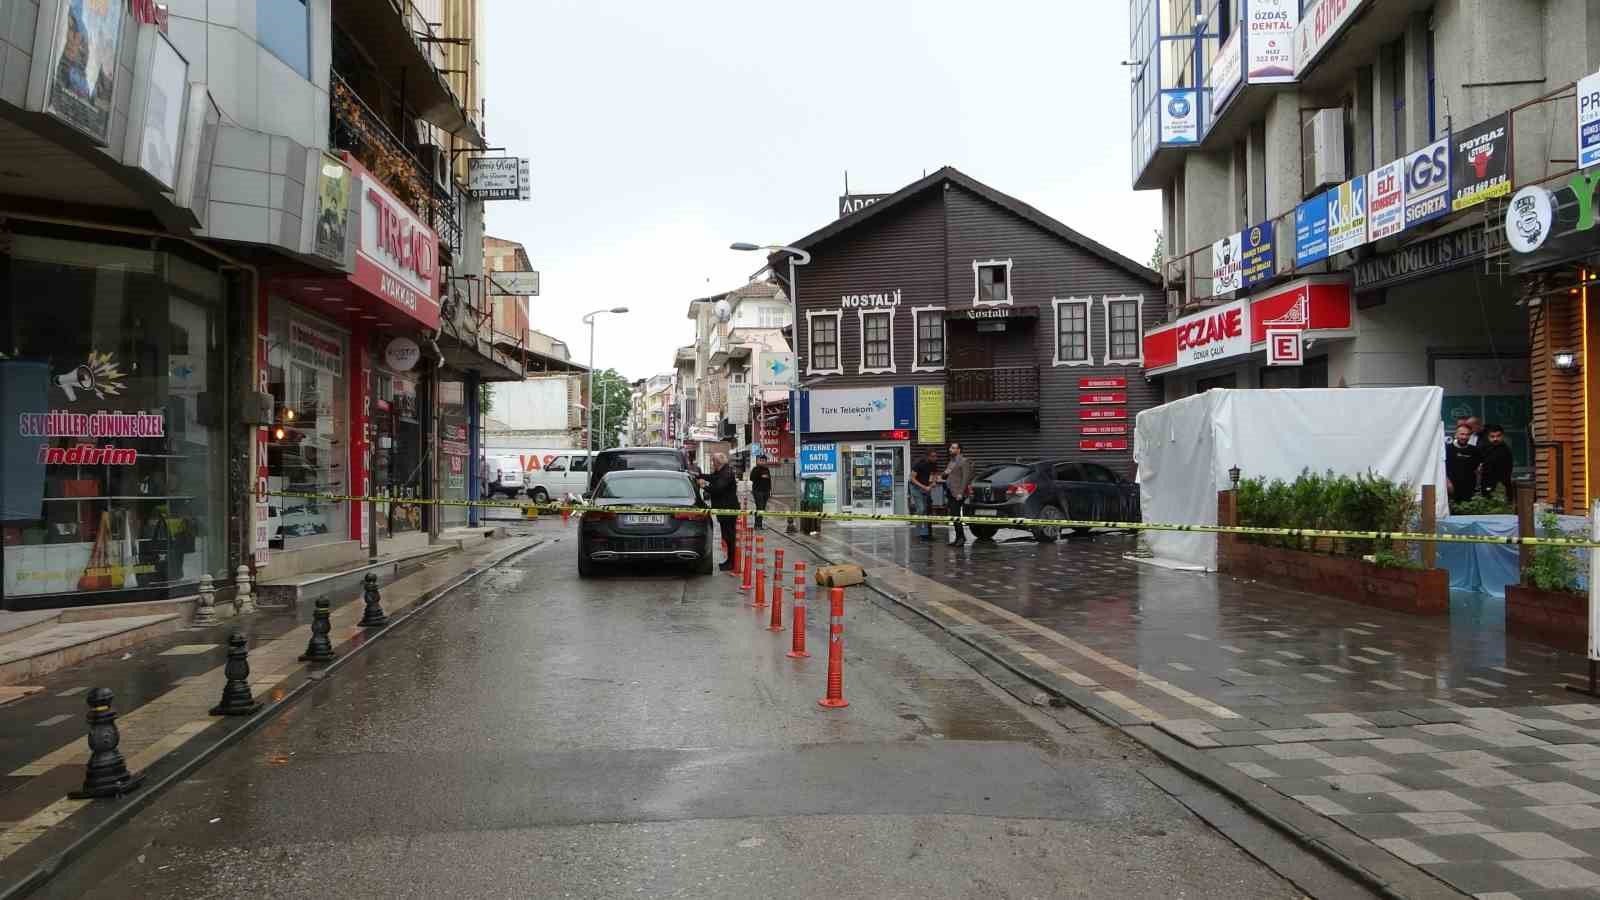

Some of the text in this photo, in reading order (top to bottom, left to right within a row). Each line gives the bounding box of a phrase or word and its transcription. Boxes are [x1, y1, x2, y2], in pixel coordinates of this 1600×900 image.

[1252, 21, 1292, 30] DENTAL
[1255, 10, 1288, 21] ÖZDAŞ
[1459, 127, 1504, 152] POYRAZ
[1371, 190, 1403, 212] KONSEPT
[367, 187, 432, 280] TREND
[380, 273, 417, 311] AYAKKABI
[1178, 308, 1243, 351] ECZANE
[1280, 340, 1293, 357] E
[821, 406, 873, 415] Türk Telekom
[20, 410, 164, 437] SEVGİLİLER GÜNÜNE ÖZEL
[37, 443, 137, 465] indirim
